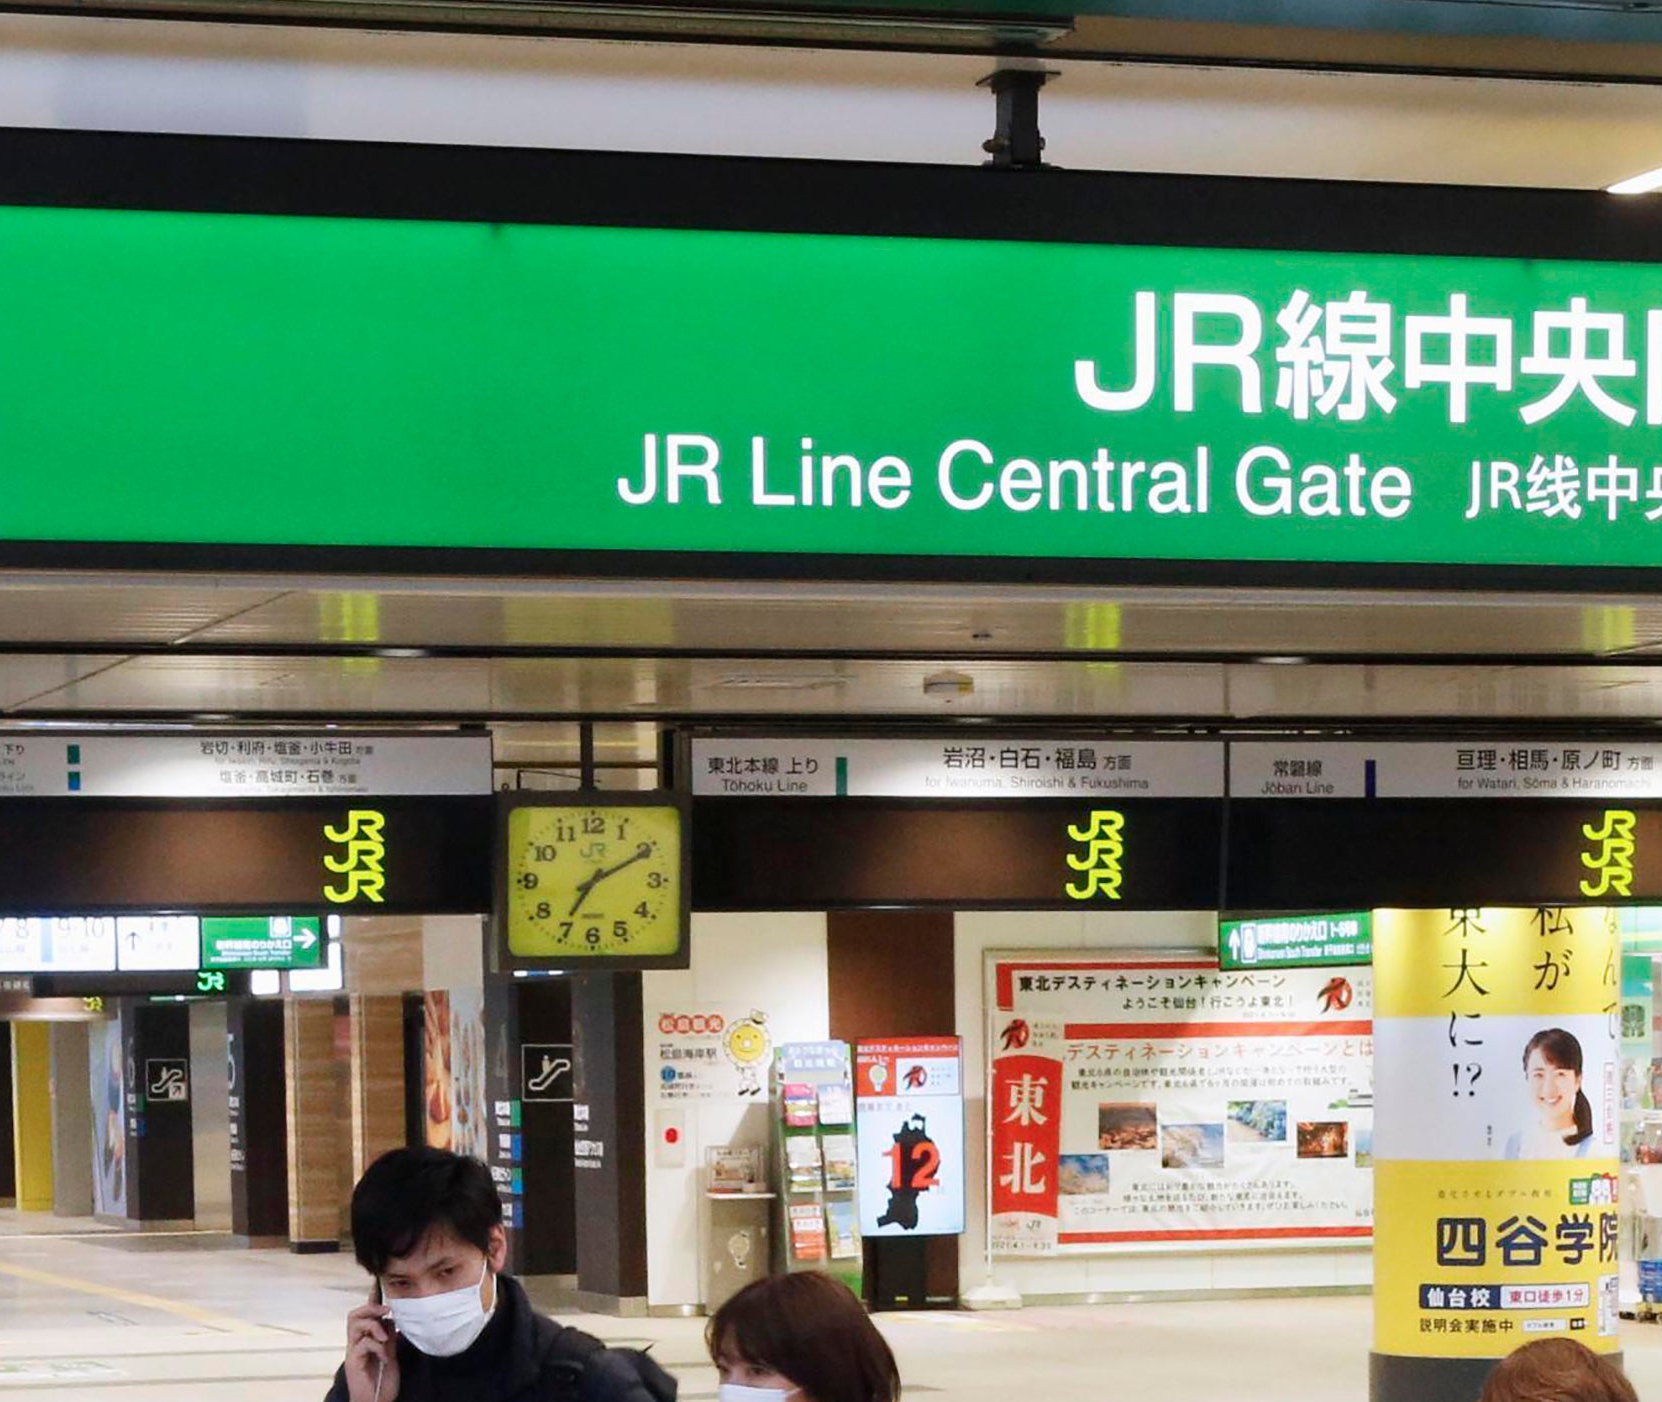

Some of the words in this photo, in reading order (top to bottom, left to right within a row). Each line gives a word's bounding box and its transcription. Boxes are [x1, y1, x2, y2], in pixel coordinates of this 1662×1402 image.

[617, 433, 722, 505] JR
[751, 436, 912, 509] Line
[936, 439, 1208, 518] Central
[1235, 445, 1412, 518] Gate
[707, 757, 780, 775] 東北本線
[785, 757, 820, 775] 上り
[942, 747, 1098, 771] 岩沼・白石・福島
[1103, 755, 1133, 771] 方面
[1456, 750, 1621, 771] 亘理・相馬・原ノ町
[1627, 757, 1655, 771] 方面
[721, 778, 775, 793] Tōhoku
[778, 778, 808, 793] Line
[1009, 775, 1065, 789] Shiroishi
[1068, 775, 1078, 788] &
[1080, 775, 1150, 790] Fukushima
[1261, 780, 1303, 795] Jōban
[1306, 780, 1335, 795] Line
[1458, 777, 1475, 790] for
[1477, 777, 1521, 792] Watari,
[1524, 776, 1559, 790] Sōma
[1561, 777, 1571, 790] &
[1572, 776, 1652, 791] Haranomachi
[556, 825, 576, 843] 11
[580, 817, 605, 835] 12
[616, 824, 626, 840] 1
[534, 844, 557, 862] 10
[524, 872, 539, 890] 9
[647, 872, 663, 890] 3
[537, 902, 551, 920] 8
[634, 901, 650, 919] 4
[559, 921, 574, 940] 7
[585, 927, 601, 945] 6
[613, 920, 629, 939] 5
[1529, 908, 1574, 992] 私が
[1018, 974, 1287, 992] 東北デスティネーションキャンペーン
[1000, 1073, 1049, 1195] 東北
[882, 1140, 940, 1190] 12
[1426, 1286, 1492, 1309] 仙台校
[1509, 1289, 1584, 1304] 東口徒歩1分
[1419, 1317, 1514, 1335] 説明会実施中
